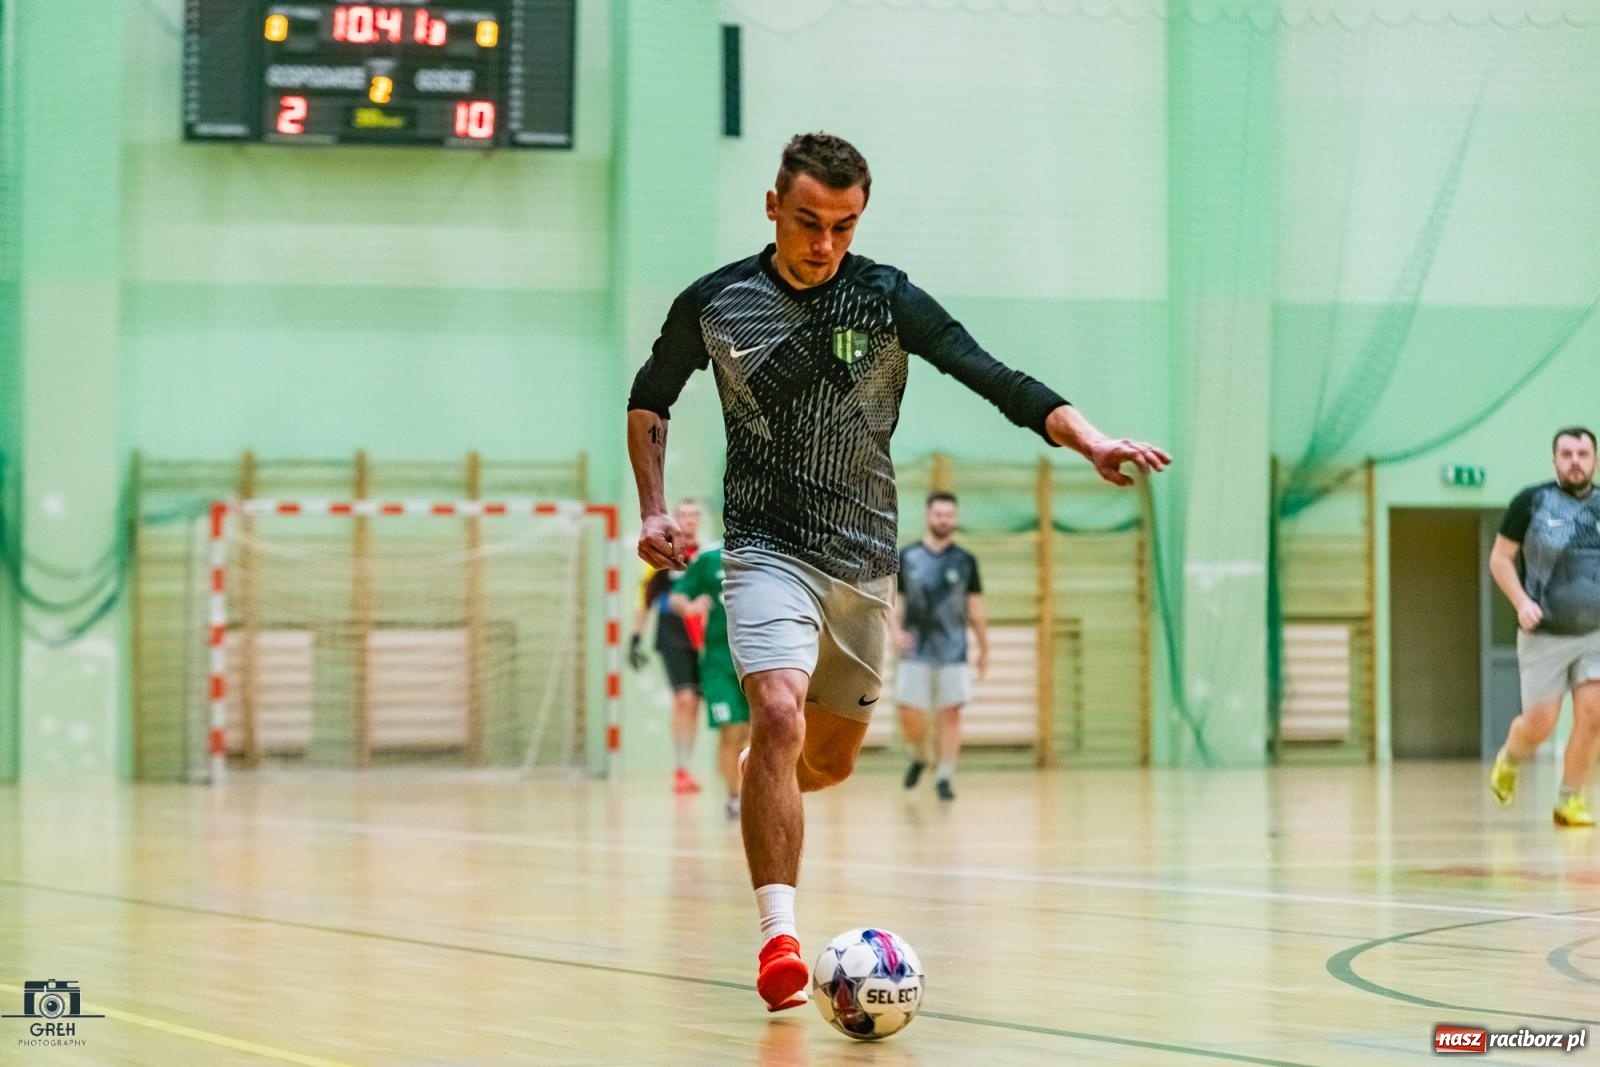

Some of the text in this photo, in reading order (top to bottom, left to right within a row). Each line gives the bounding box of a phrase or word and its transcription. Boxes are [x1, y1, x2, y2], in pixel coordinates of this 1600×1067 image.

[275, 95, 309, 134] 2
[454, 101, 496, 139] 10
[866, 986, 918, 1005] SELECT
